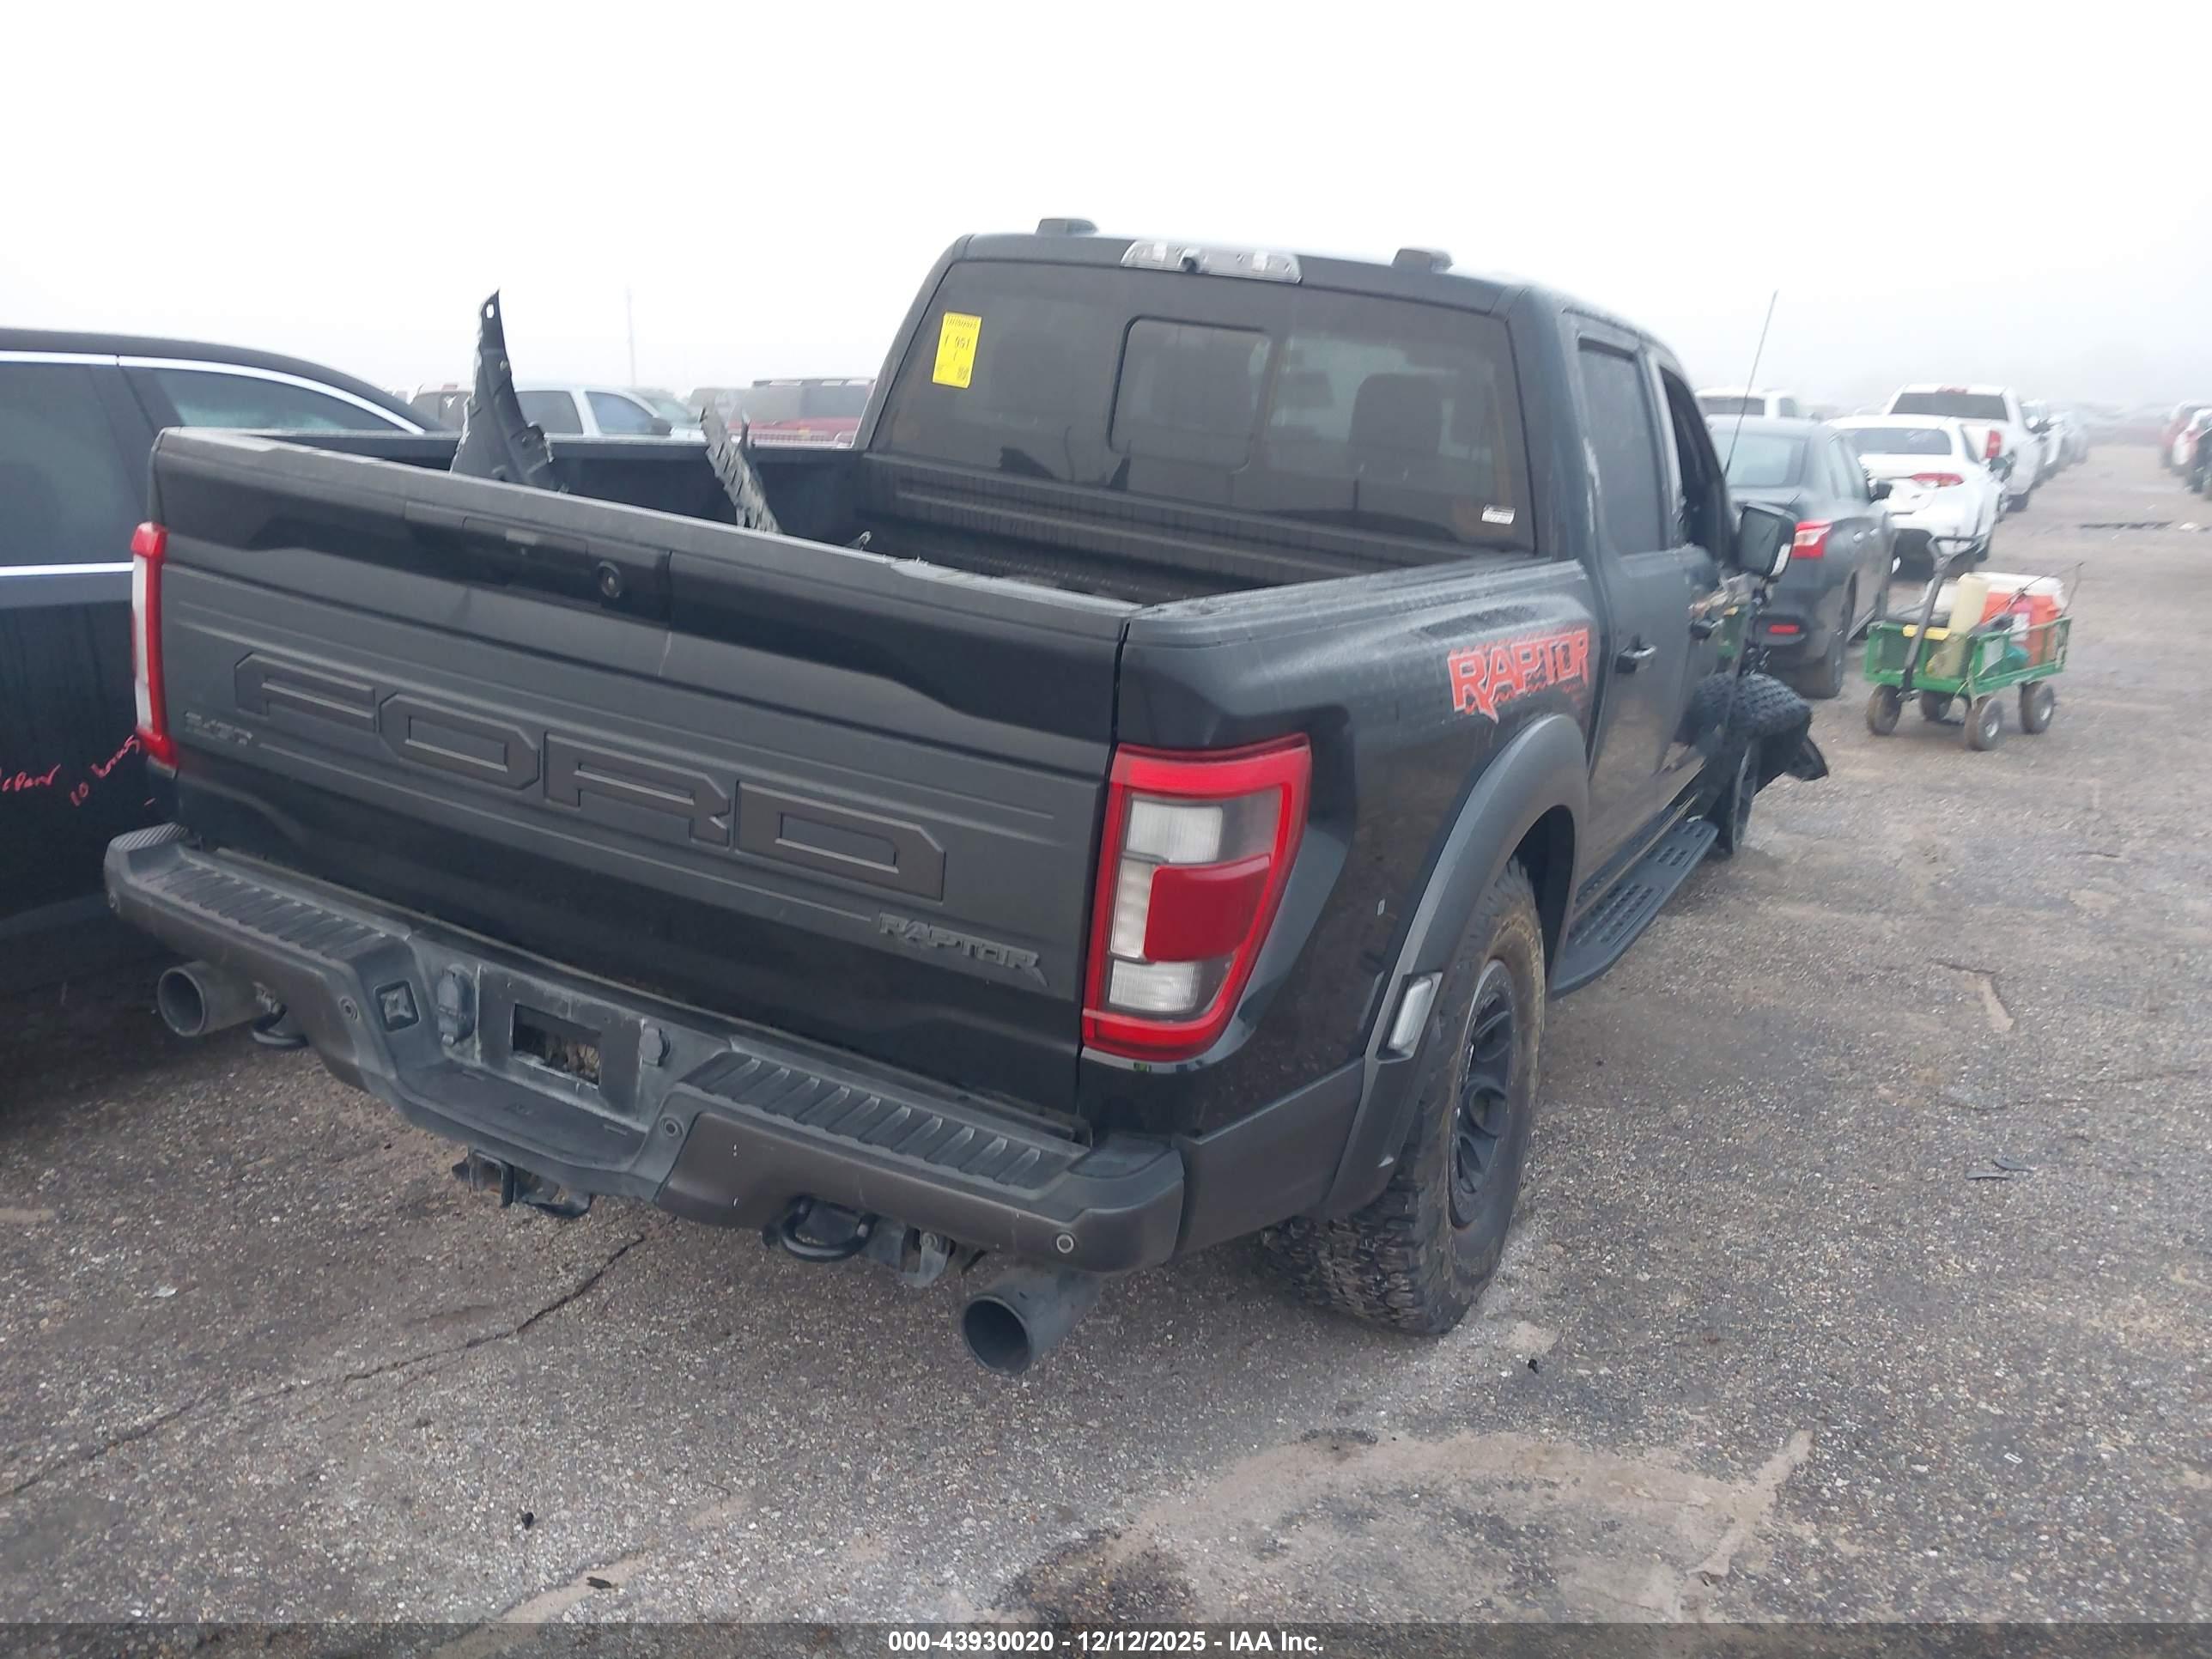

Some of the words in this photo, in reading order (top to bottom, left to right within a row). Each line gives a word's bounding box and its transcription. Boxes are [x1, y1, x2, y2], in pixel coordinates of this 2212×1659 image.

[1447, 628, 1589, 725] RAPTOR
[234, 651, 946, 902] FORD
[878, 911, 1049, 988] RAPTOR
